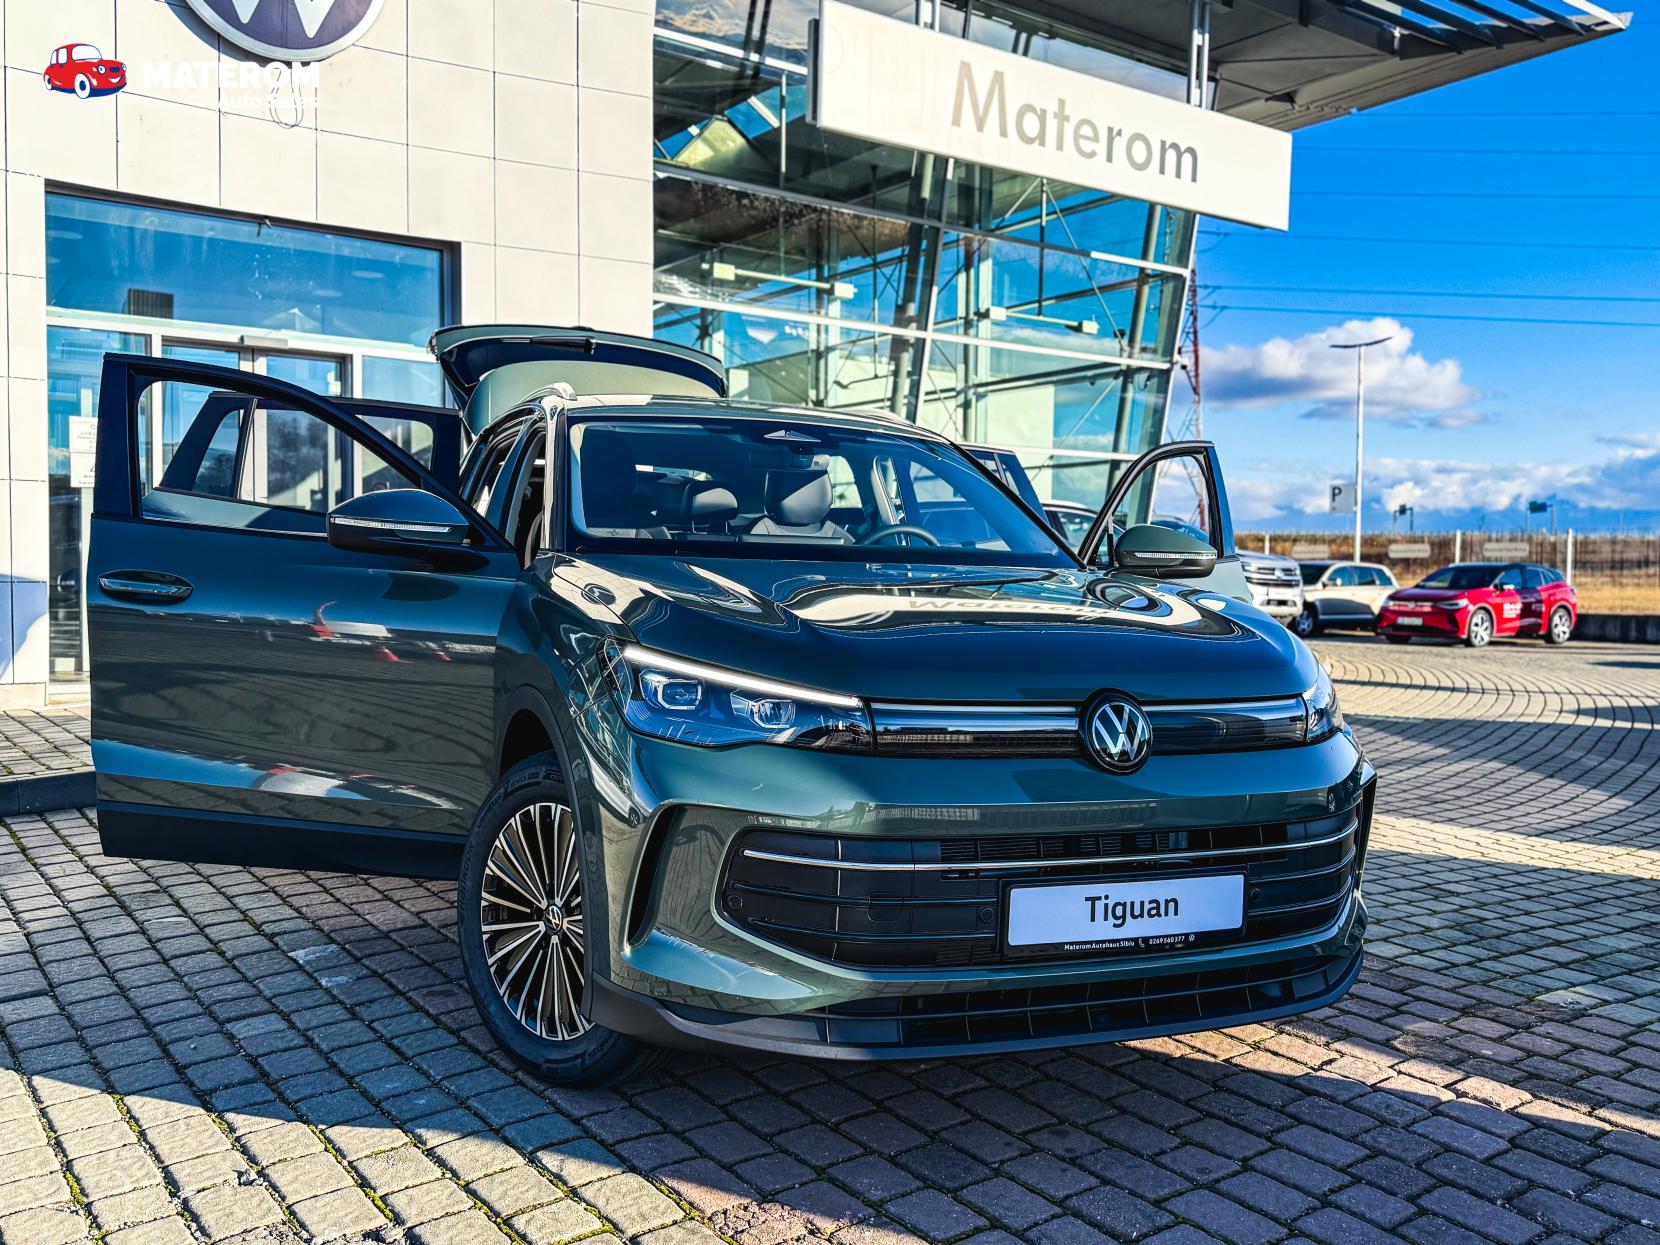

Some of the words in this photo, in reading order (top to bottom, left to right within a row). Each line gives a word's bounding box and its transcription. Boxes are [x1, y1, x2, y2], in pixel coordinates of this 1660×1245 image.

[951, 60, 1198, 183] Materom
[1332, 487, 1342, 502] P
[1085, 894, 1179, 927] Tiguan
[1064, 943, 1091, 951] Materom
